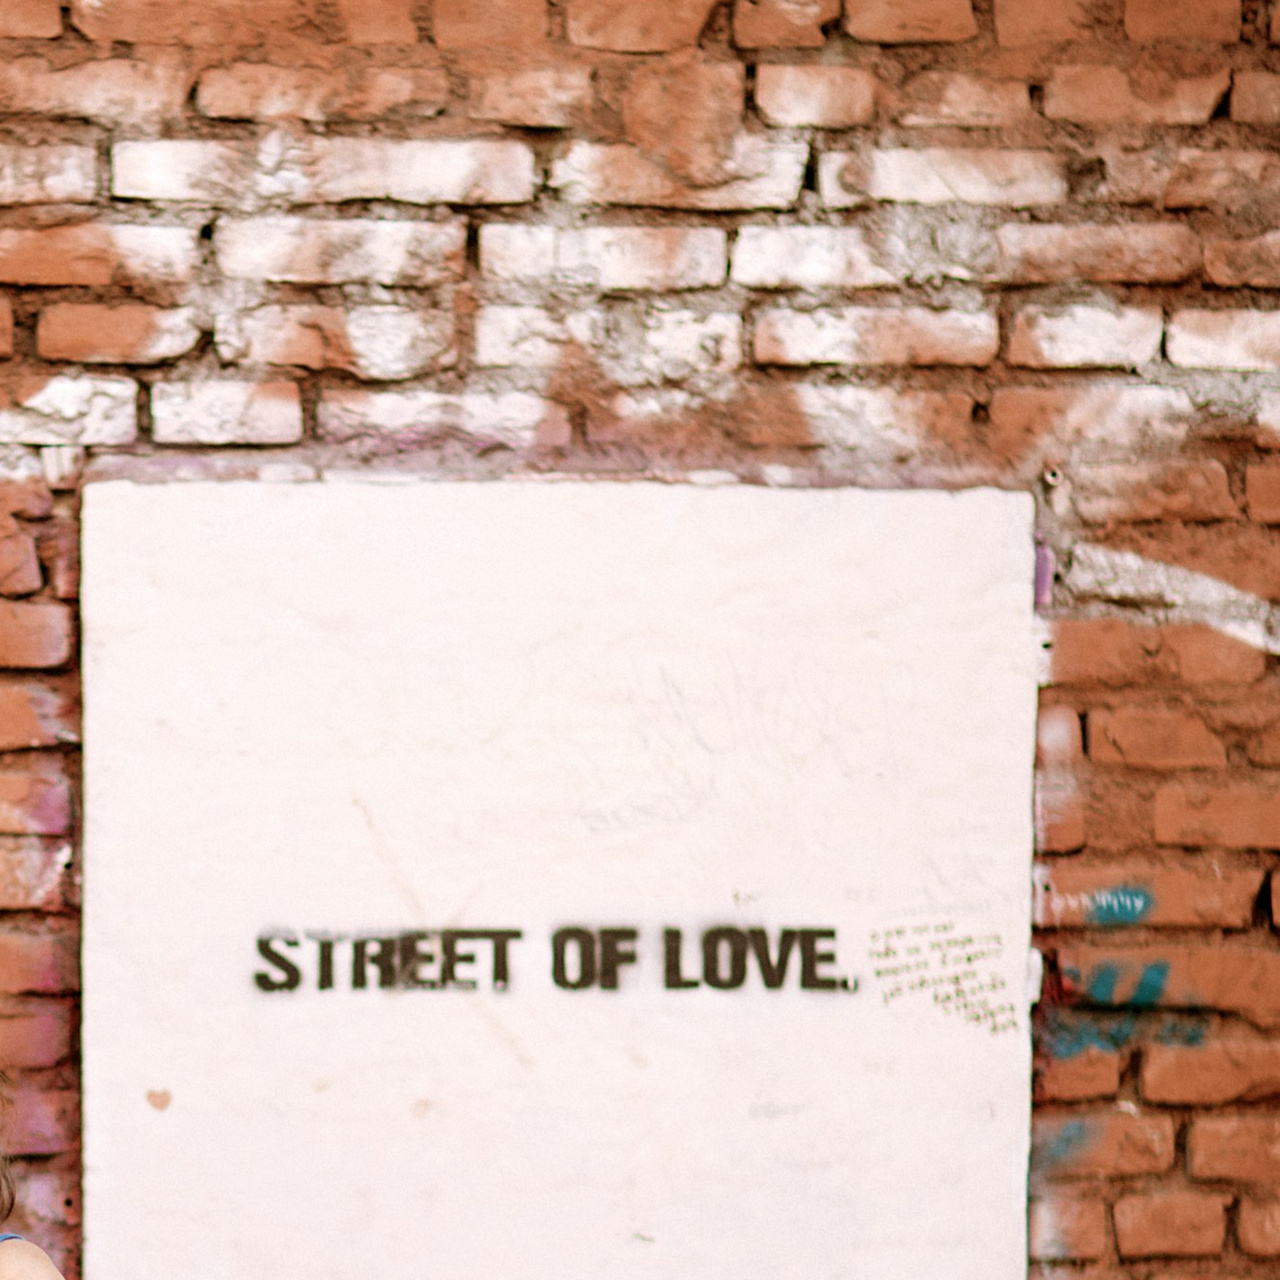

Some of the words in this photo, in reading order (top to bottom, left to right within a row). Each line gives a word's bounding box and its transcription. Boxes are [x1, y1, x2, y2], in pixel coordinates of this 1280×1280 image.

[254, 927, 522, 992] STREET
[552, 926, 638, 991] OF
[663, 926, 858, 992] LOVE.
